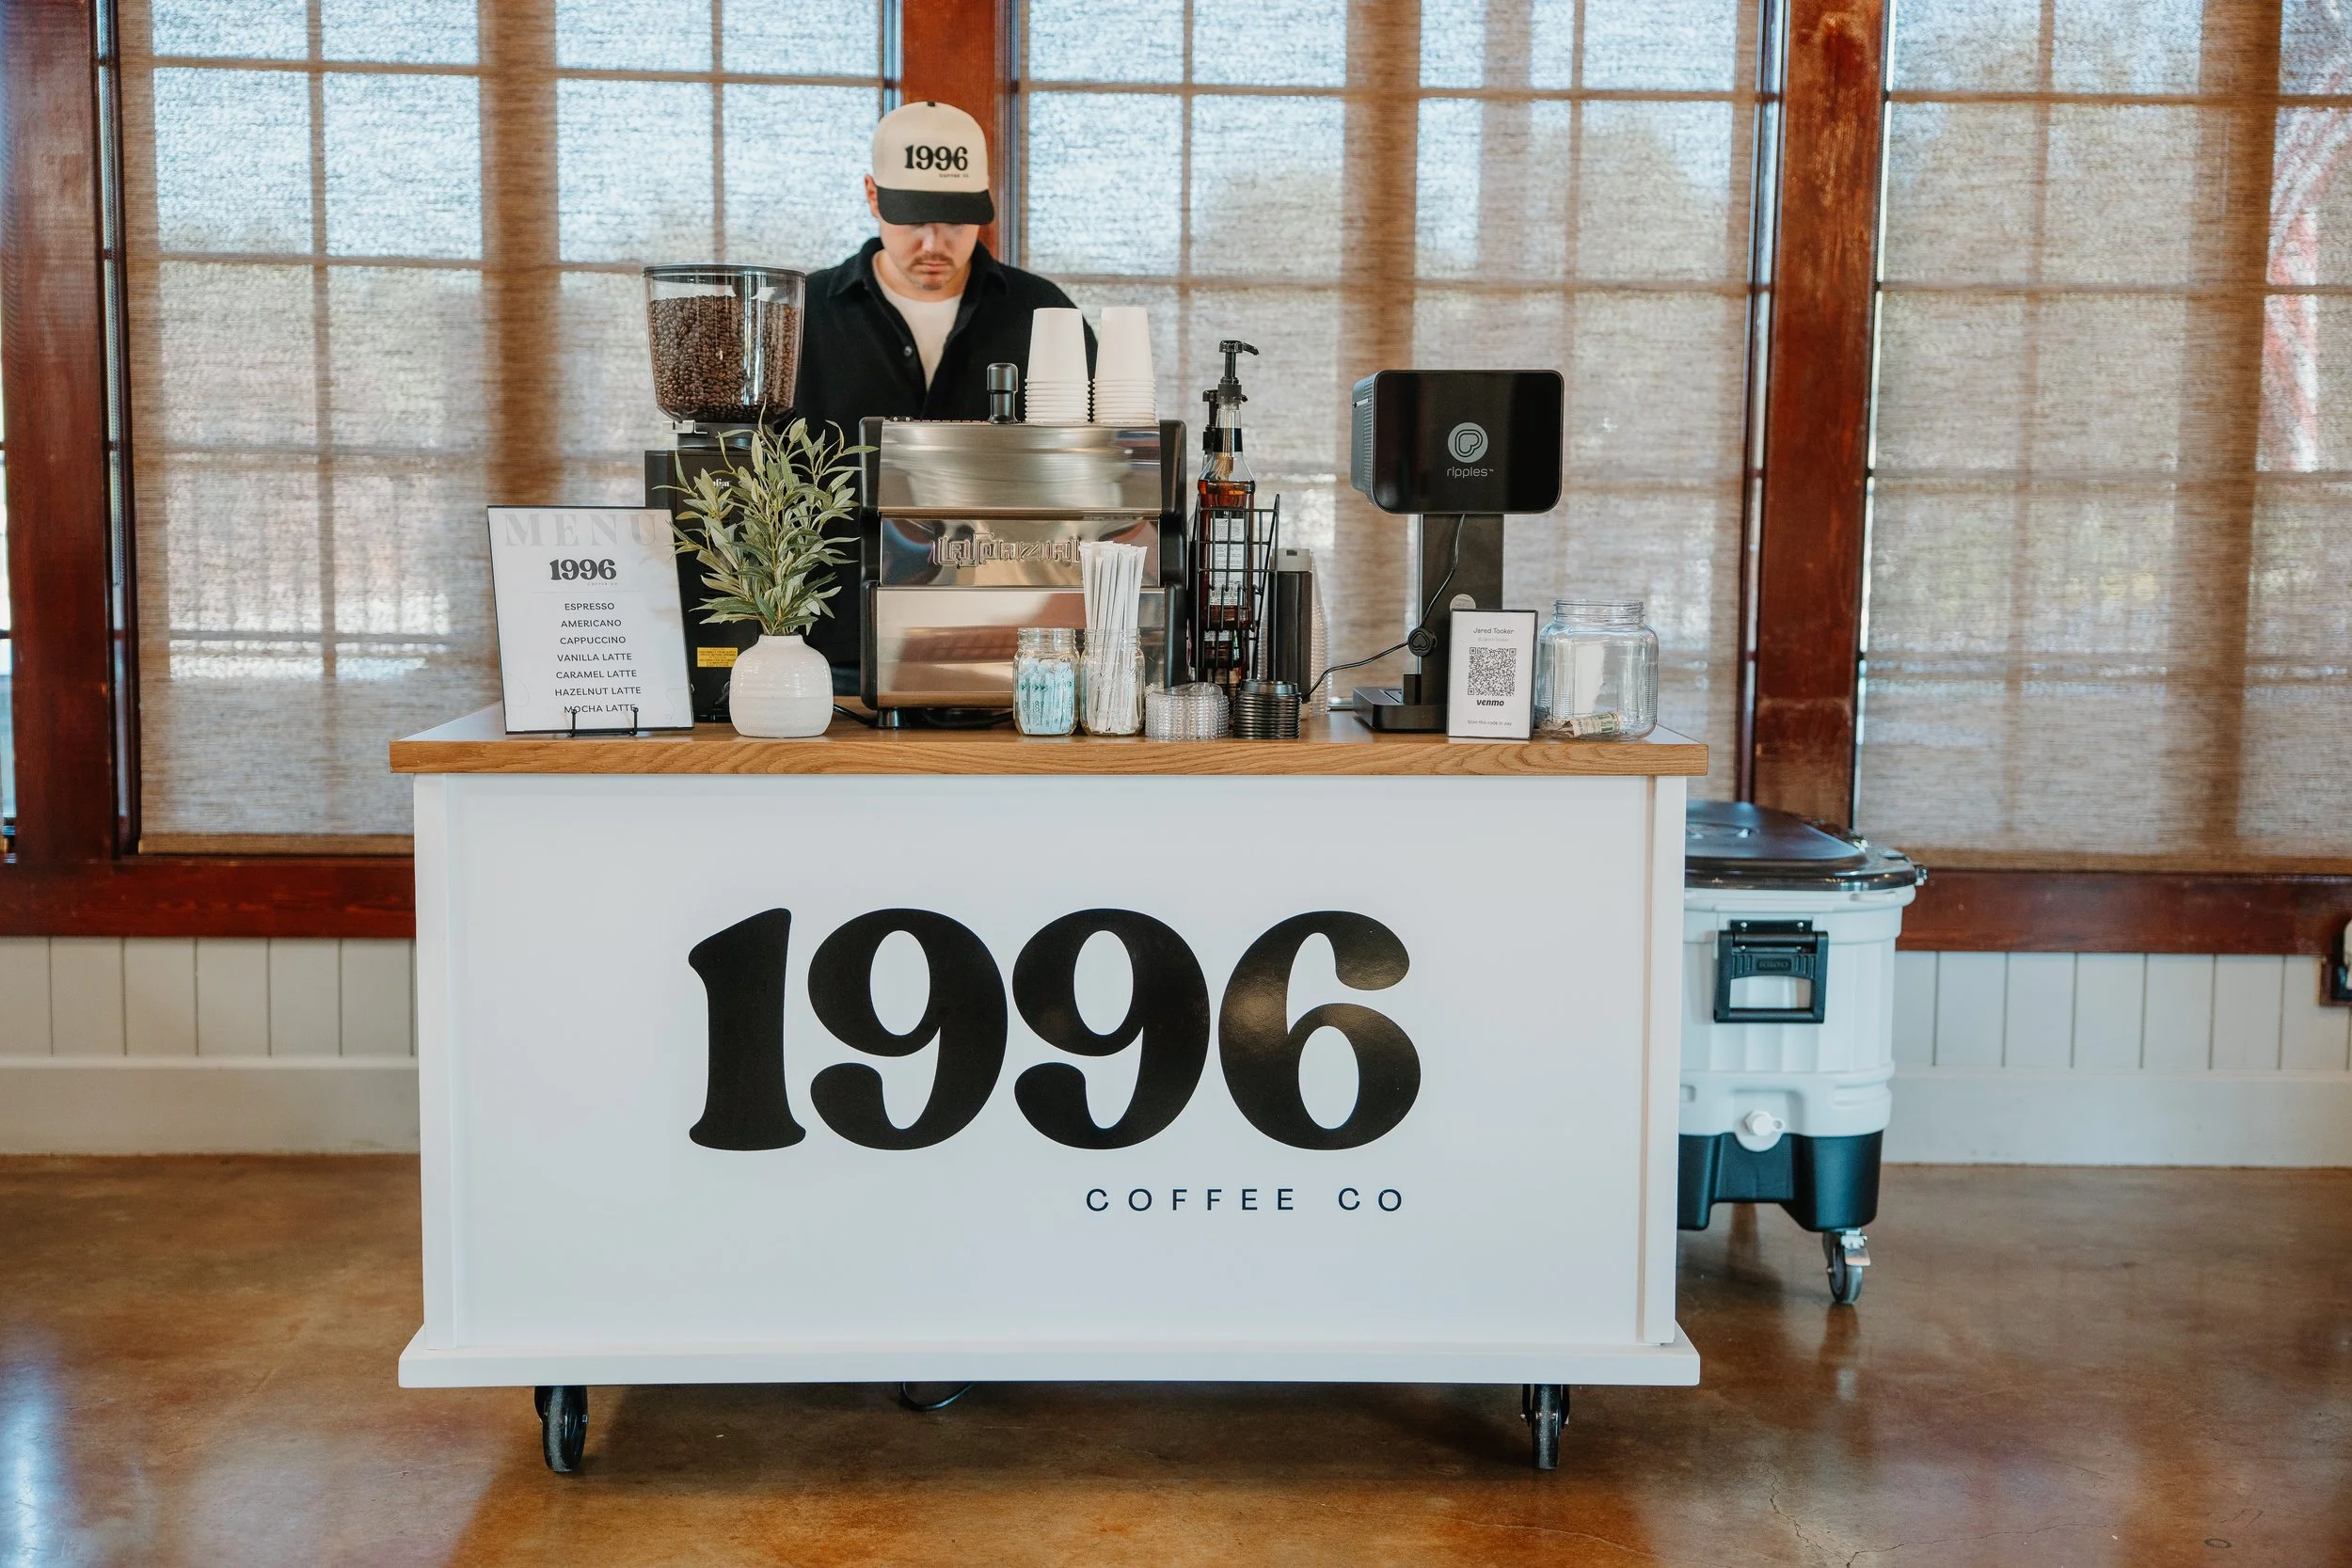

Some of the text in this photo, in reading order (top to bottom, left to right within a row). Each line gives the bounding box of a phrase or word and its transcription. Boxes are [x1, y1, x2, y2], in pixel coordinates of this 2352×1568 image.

[904, 144, 968, 170] 1996
[504, 514, 657, 546] MENU
[549, 559, 617, 580] 1996
[564, 602, 615, 610] ESPRESSO
[561, 619, 622, 628] AMERICANO
[560, 636, 627, 645] CAPPUCCINO
[557, 653, 632, 662] VANILLA LATTE
[556, 669, 637, 679] CARAMEL LATTE
[555, 686, 642, 697] HAZELNUT LATTE
[564, 704, 636, 714] MOCHA LATTE
[688, 907, 1422, 1151] 1996
[1086, 1187, 1403, 1212] COFFEE CO
